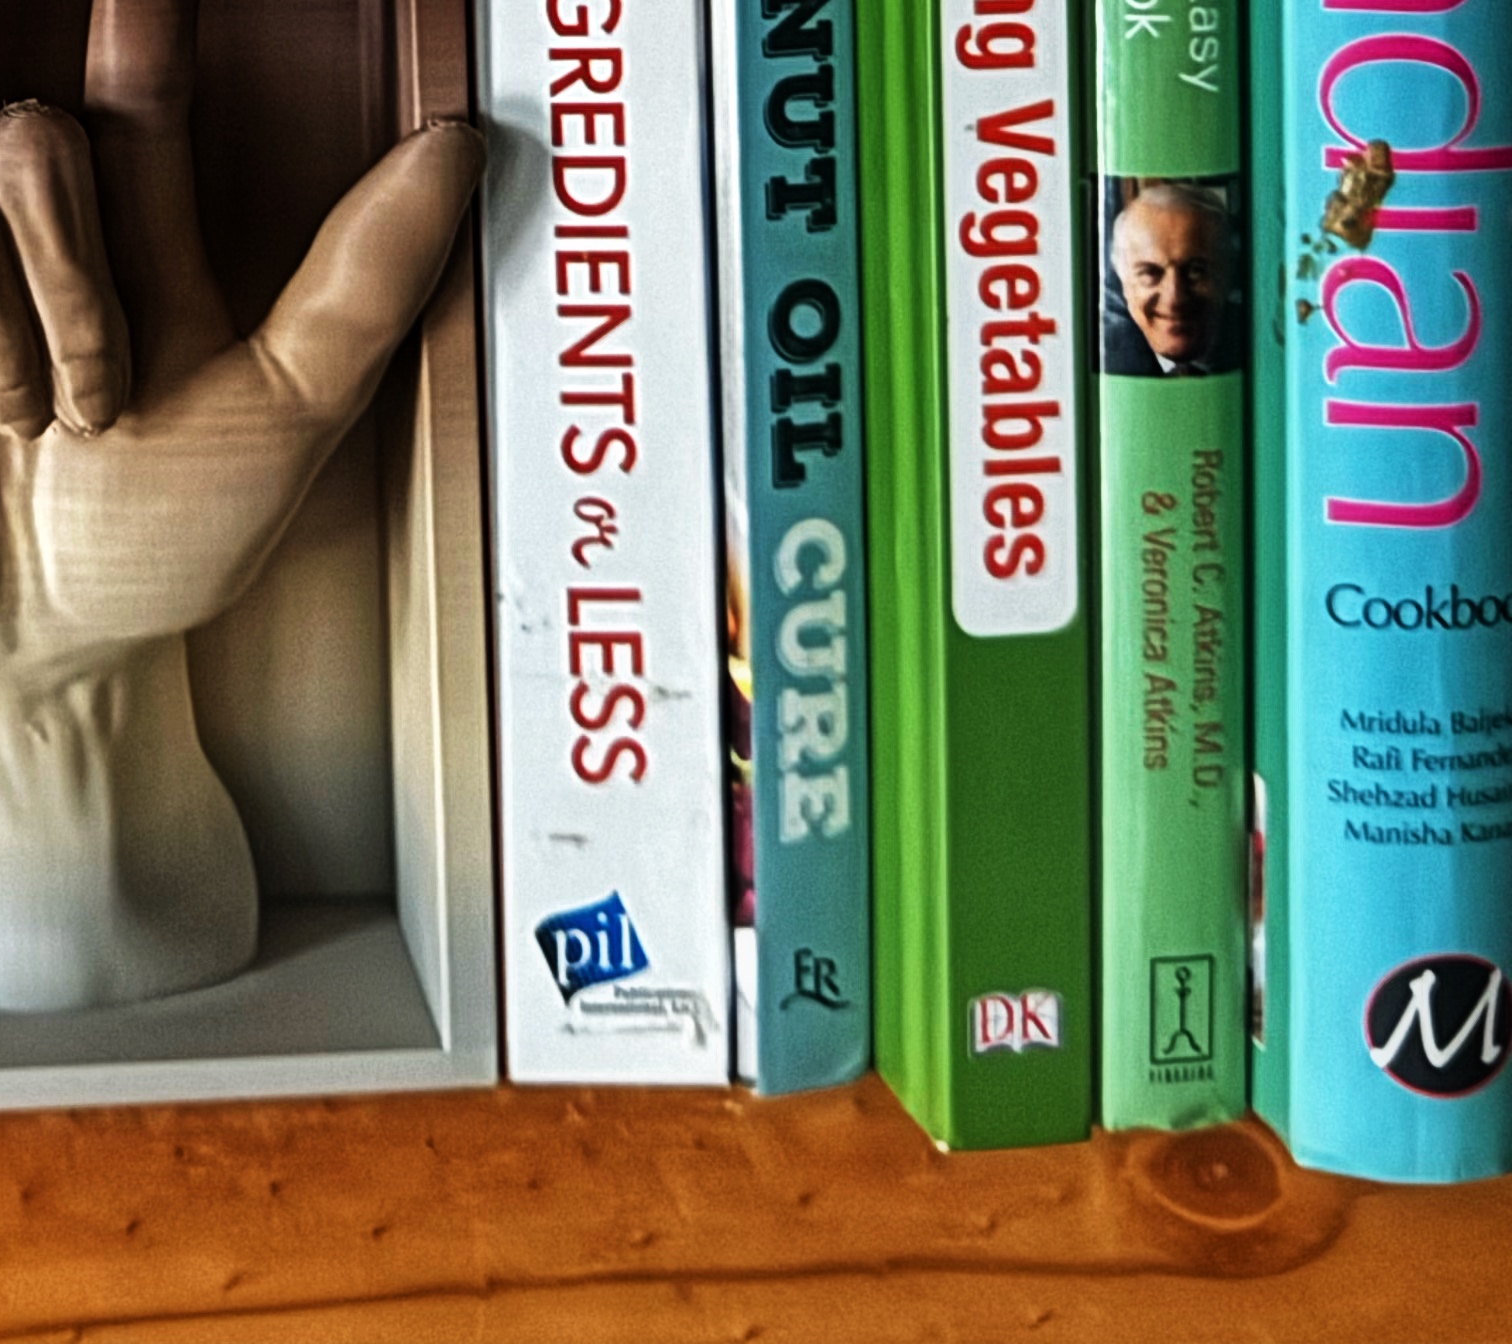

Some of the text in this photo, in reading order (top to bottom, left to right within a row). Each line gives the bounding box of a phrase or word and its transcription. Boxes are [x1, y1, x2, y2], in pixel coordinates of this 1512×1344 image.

[960, 97, 1064, 581] Vegetables
[765, 277, 846, 490] OIL
[568, 497, 621, 569] or
[1189, 449, 1225, 712] Robert C. Atkins,
[1141, 490, 1179, 772] & Veronica Atkins
[565, 585, 649, 786] LESS
[774, 517, 853, 845] CURE
[1340, 708, 1442, 736] Mridula
[1352, 743, 1403, 773] Rafi
[1327, 779, 1438, 810] Shehzad
[1344, 818, 1453, 846] Manisha
[553, 910, 635, 990] pil
[975, 998, 1053, 1043] DK
